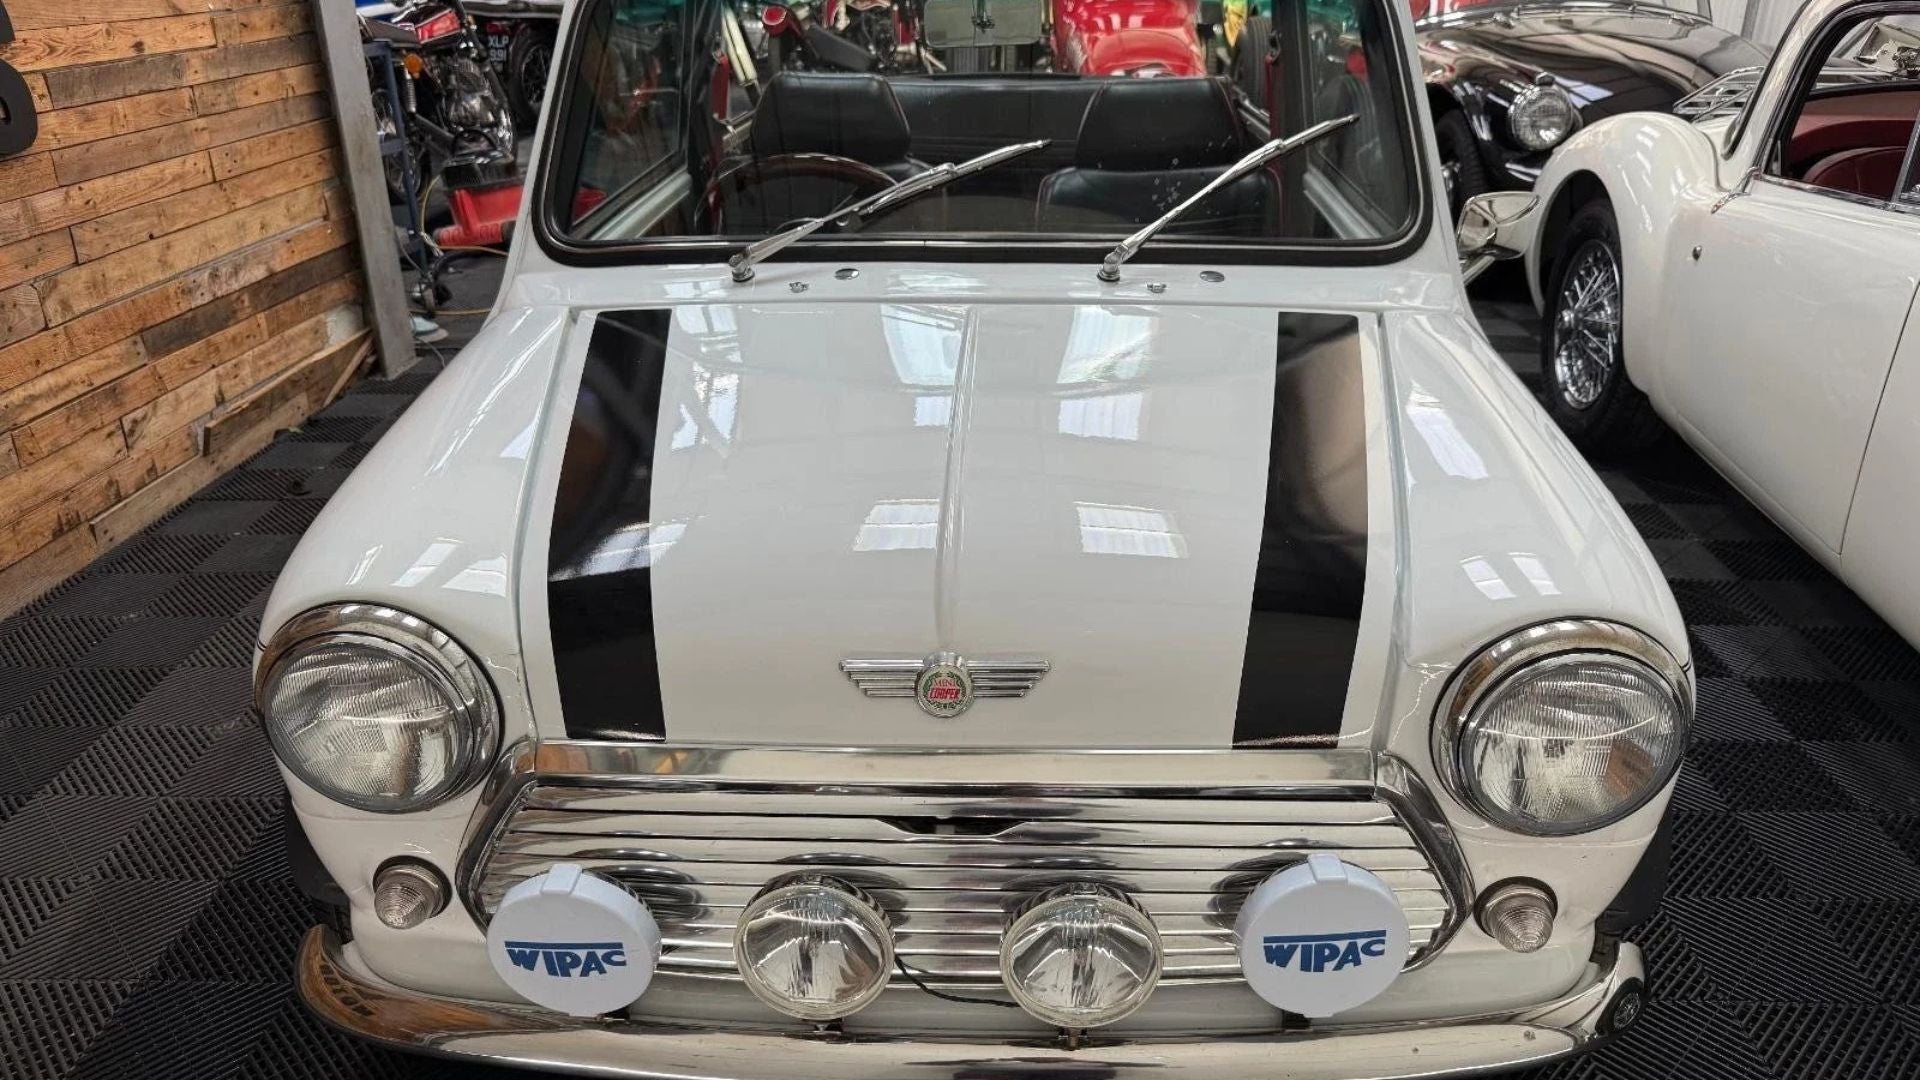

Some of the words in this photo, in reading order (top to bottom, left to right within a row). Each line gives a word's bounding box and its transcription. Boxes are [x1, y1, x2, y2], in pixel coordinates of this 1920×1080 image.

[488, 35, 510, 47] XLP
[933, 678, 957, 687] MINI
[929, 687, 961, 700] COOPER
[1263, 937, 1386, 973] WIPAC
[505, 947, 627, 977] WIPAC
